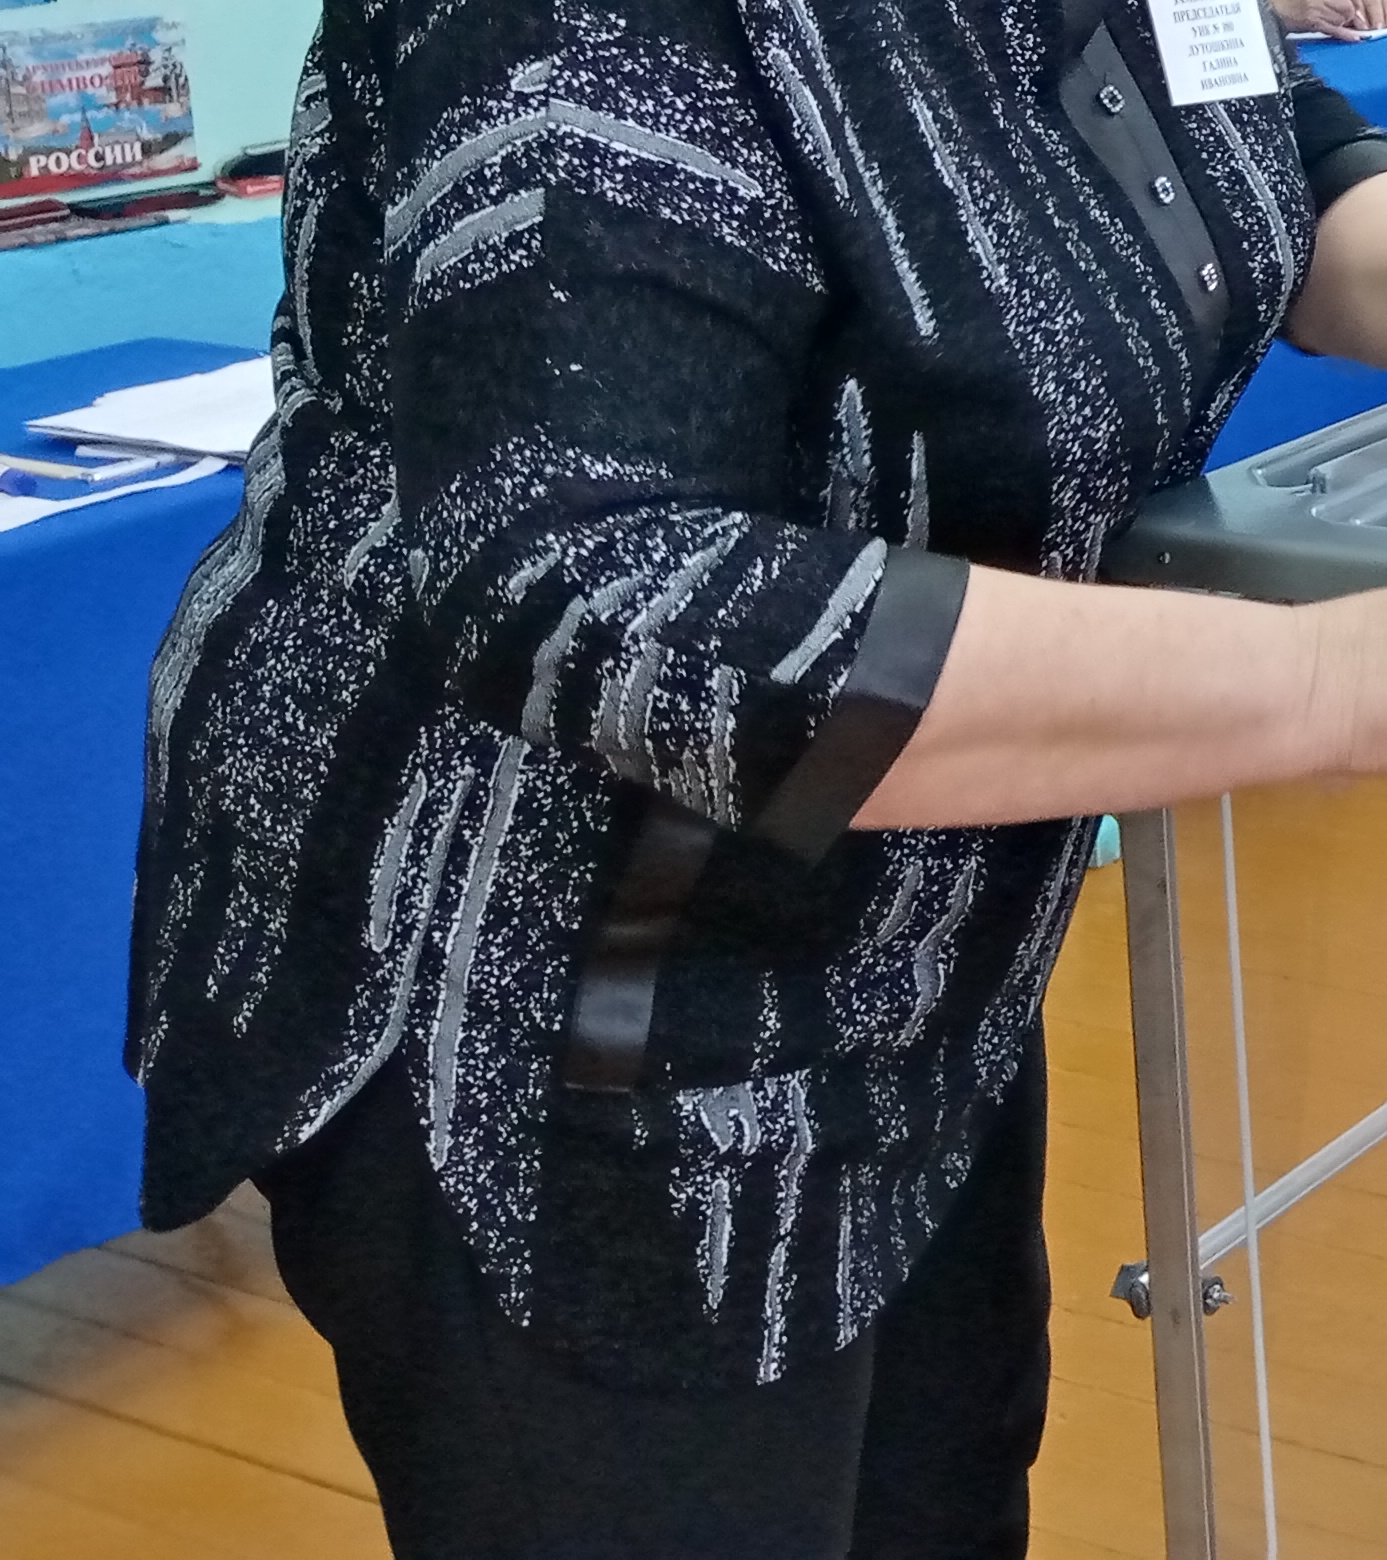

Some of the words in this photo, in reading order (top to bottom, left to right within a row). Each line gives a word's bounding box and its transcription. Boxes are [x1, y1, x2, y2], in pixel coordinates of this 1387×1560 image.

[1173, 2, 1241, 23] ПРЕДСЕДАТЕЛЯ
[1202, 57, 1238, 72] ГАЛИНА
[1200, 72, 1249, 90] ИВАНОВНА
[29, 141, 142, 177] РОССИИ
